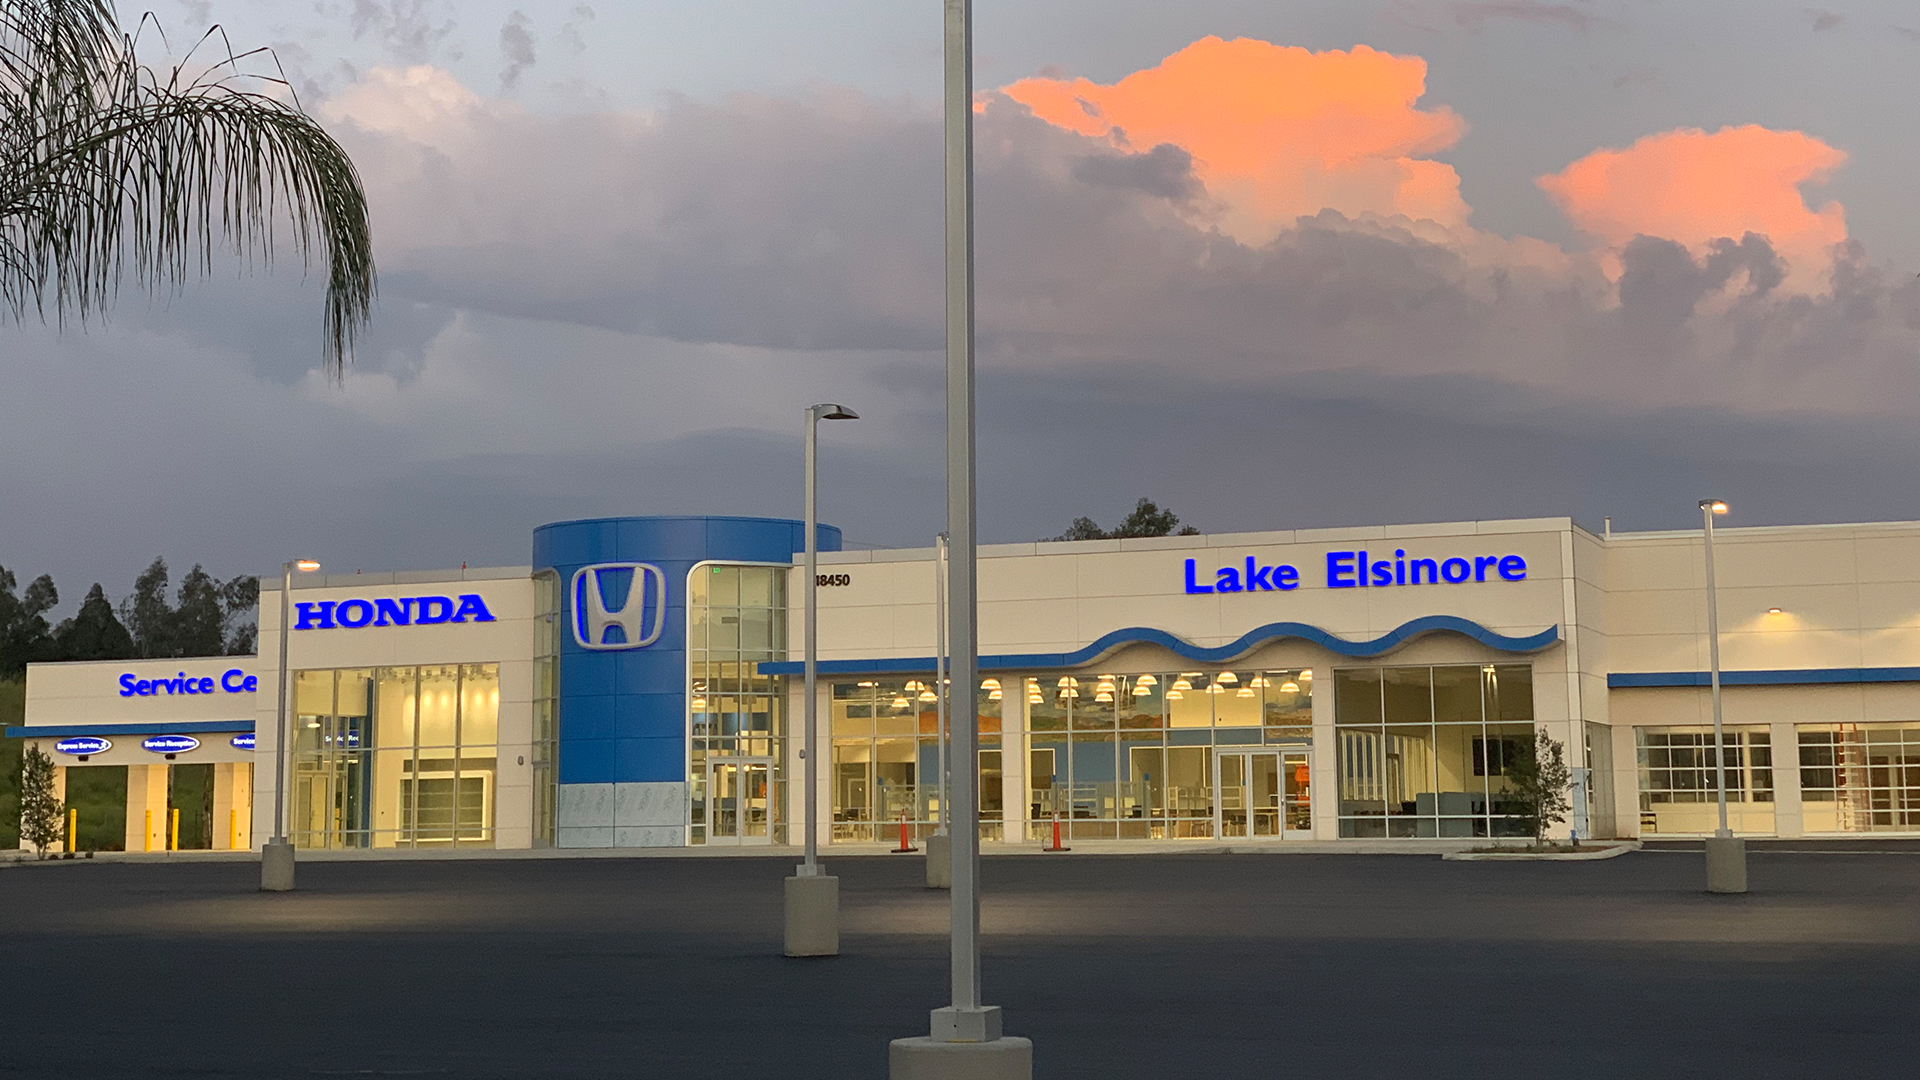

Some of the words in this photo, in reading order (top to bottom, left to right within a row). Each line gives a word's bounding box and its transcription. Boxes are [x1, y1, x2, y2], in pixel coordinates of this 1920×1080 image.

[815, 574, 851, 587] 18450
[1184, 555, 1299, 594] Lake
[1326, 548, 1527, 588] Elsinore
[294, 594, 497, 630] HONDA
[119, 671, 214, 697] Service
[57, 743, 78, 751] Express
[144, 740, 166, 748] Service
[166, 740, 196, 748] Reception
